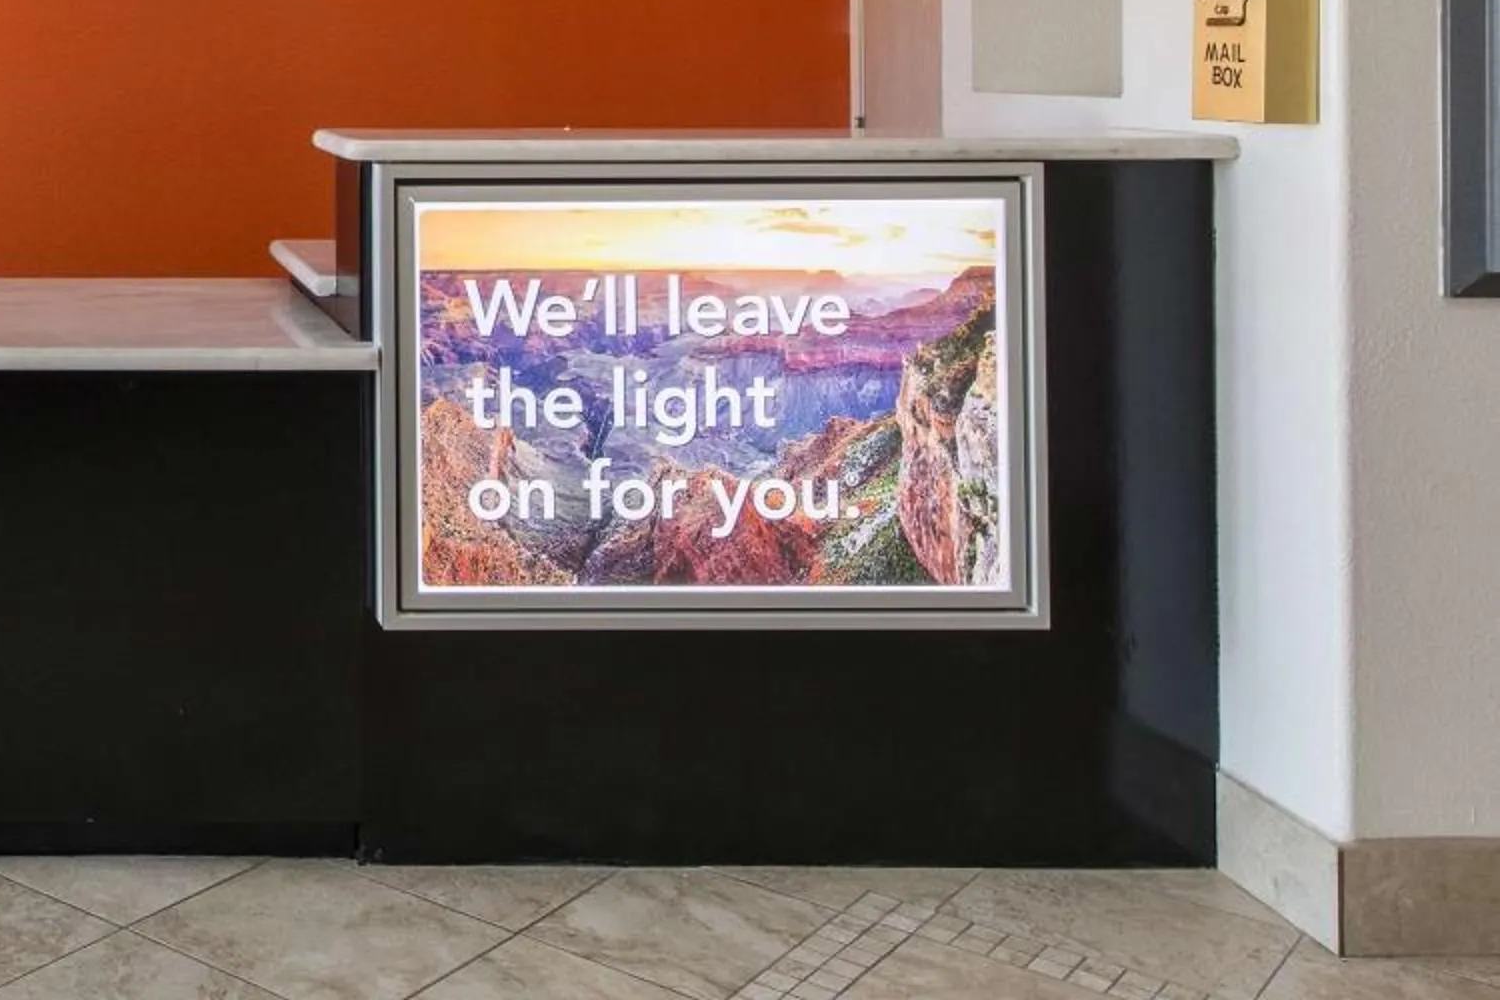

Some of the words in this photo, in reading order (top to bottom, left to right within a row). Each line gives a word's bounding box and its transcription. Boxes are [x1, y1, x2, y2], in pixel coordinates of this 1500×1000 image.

[1204, 42, 1246, 63] MAIL
[1212, 65, 1243, 89] BOX
[669, 274, 852, 337] leave
[466, 367, 584, 429] the
[614, 367, 777, 447] light
[467, 478, 555, 521] on
[584, 457, 689, 521] for
